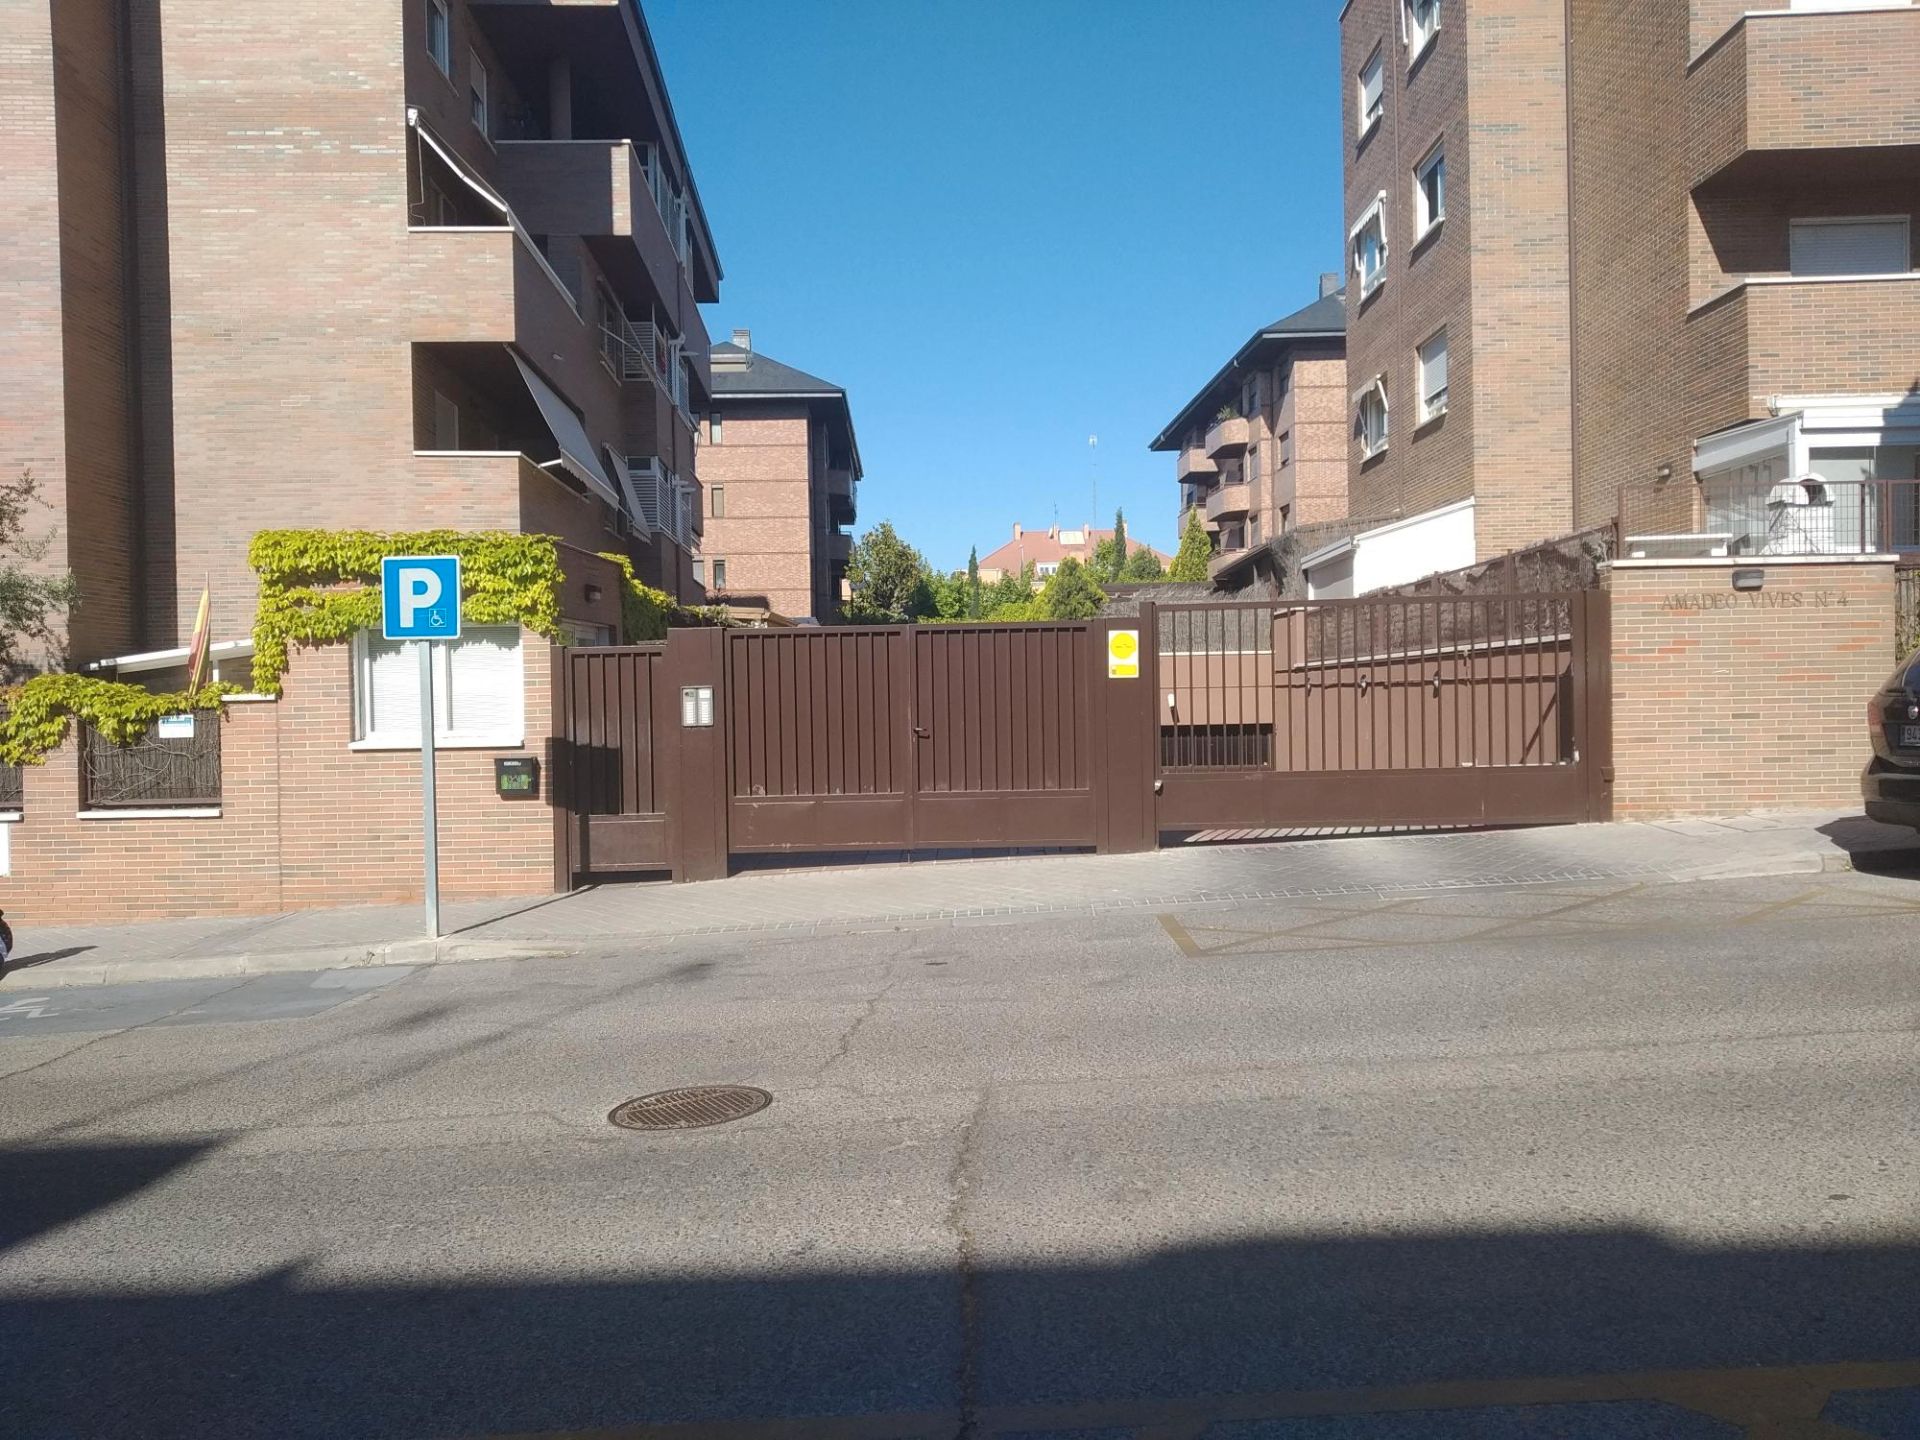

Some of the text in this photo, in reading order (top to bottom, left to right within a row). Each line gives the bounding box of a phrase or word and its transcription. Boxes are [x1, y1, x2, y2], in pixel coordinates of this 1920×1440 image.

[398, 568, 442, 628] P
[1661, 593, 1738, 609] AMADEO
[1746, 592, 1803, 608] VIVES
[1836, 591, 1849, 606] 4
